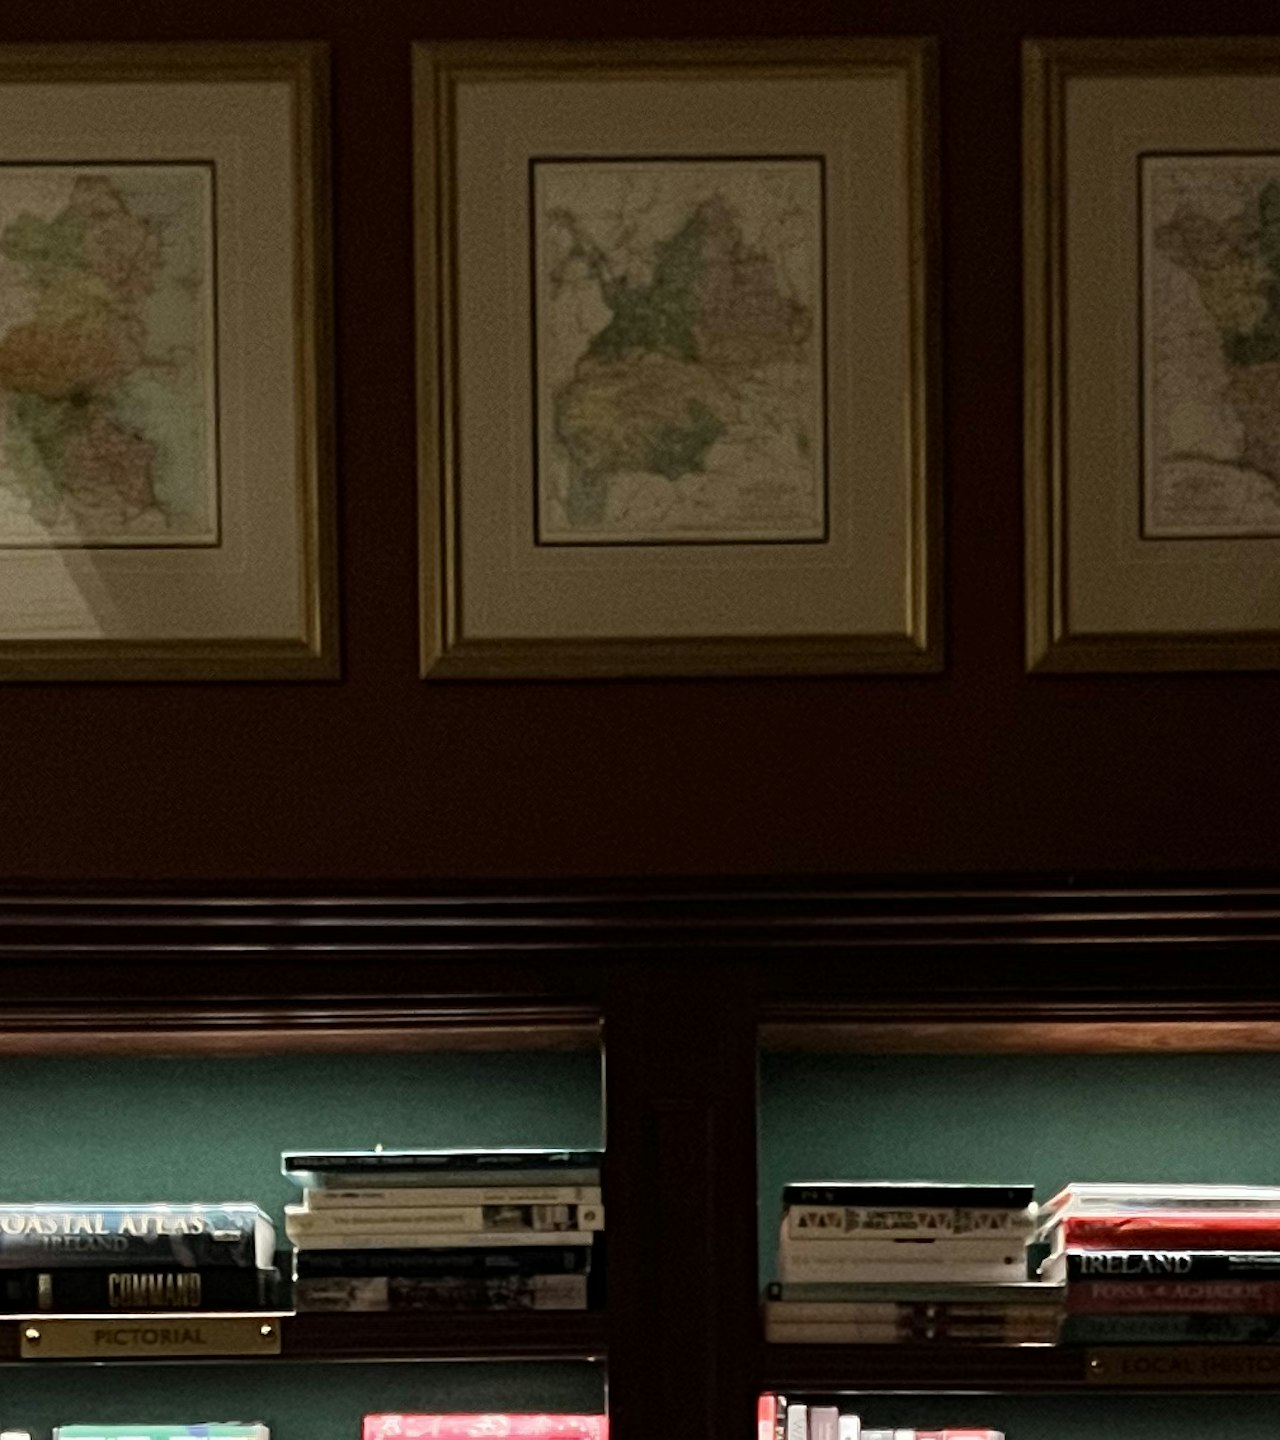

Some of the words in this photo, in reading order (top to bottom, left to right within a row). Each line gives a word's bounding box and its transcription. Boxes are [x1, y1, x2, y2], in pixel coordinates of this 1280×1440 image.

[118, 1211, 206, 1236] ATLAS
[1079, 1254, 1194, 1274] IRELAND
[107, 1272, 202, 1308] COMMAND
[94, 1327, 208, 1346] PICTORIAL
